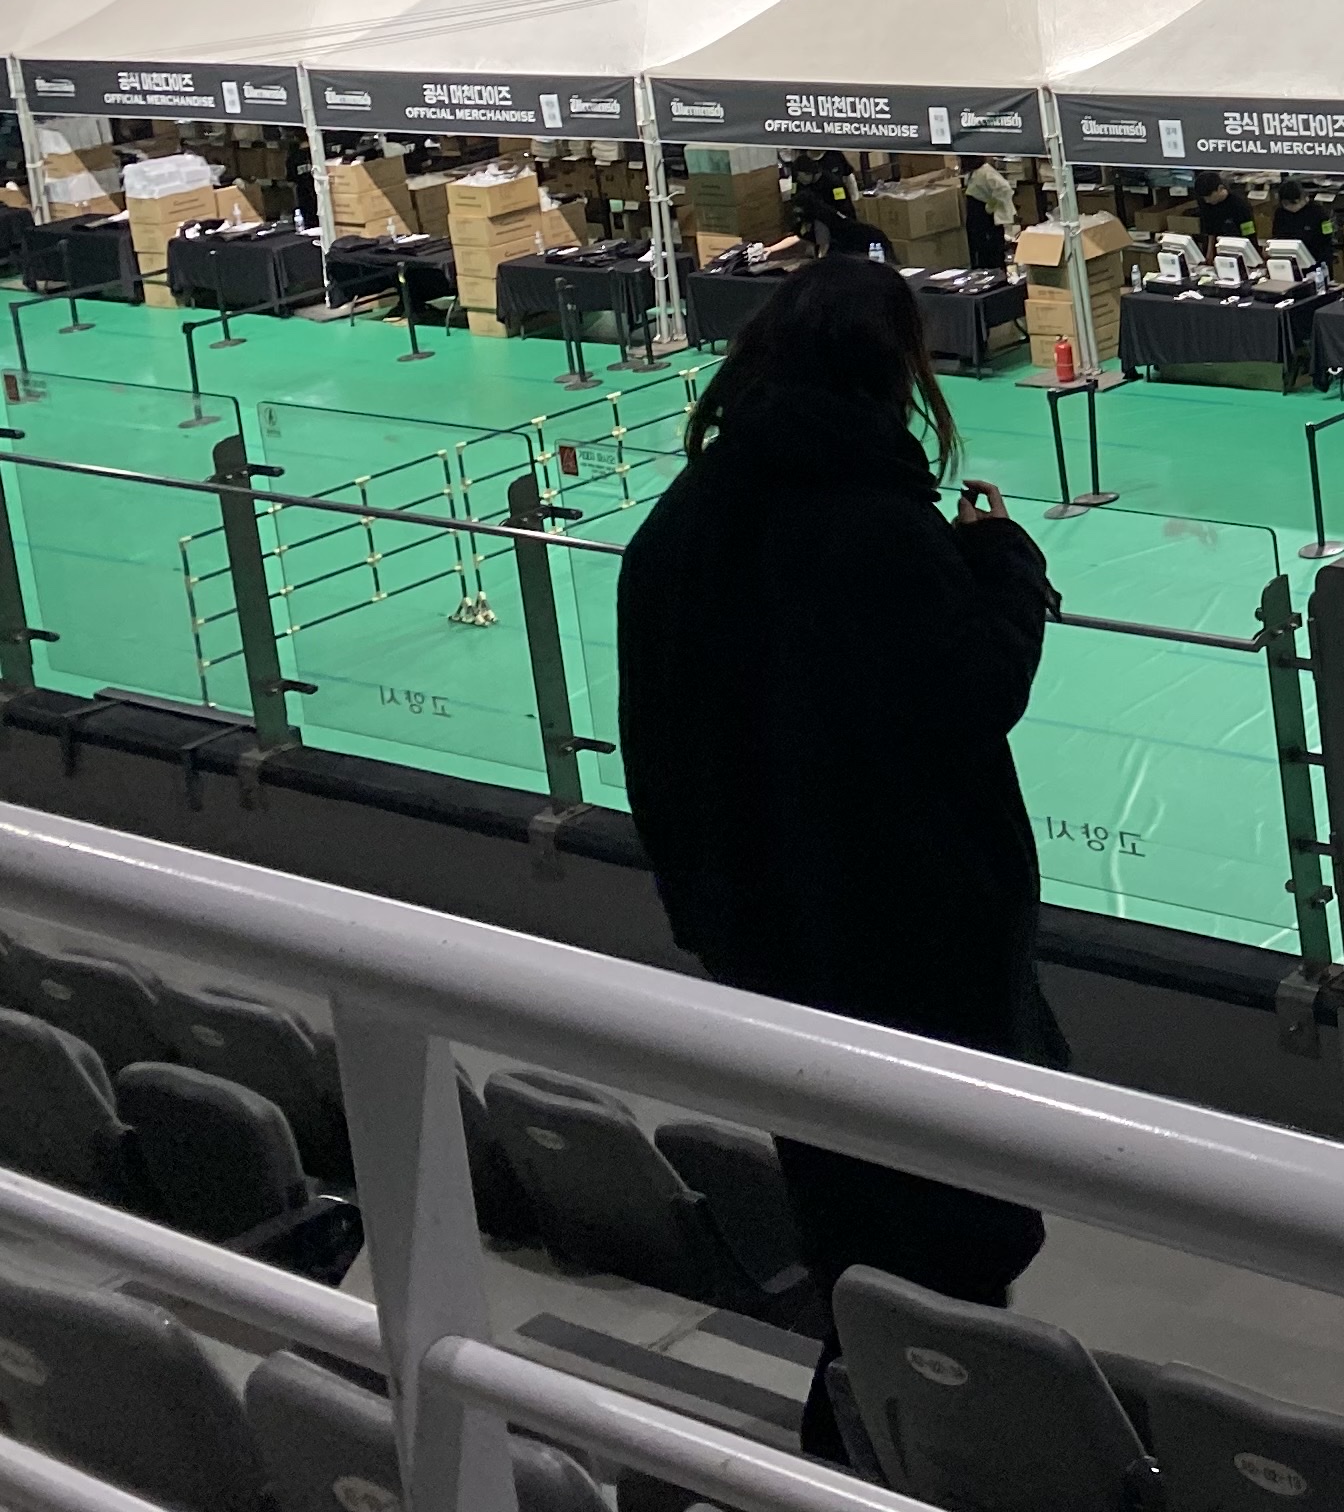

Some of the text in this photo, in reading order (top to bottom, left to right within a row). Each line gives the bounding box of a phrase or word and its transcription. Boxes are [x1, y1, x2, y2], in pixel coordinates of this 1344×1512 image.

[423, 83, 512, 106] 공식 머천다이즈
[405, 107, 536, 123] OFFICIAL MERCHANDISE
[786, 94, 891, 119] 공식 머천다이즈
[765, 119, 822, 134] OFFICIAL
[824, 122, 919, 138] MERCHANDISE
[1224, 112, 1260, 136] 공식
[1197, 139, 1267, 154] OFFICIAL
